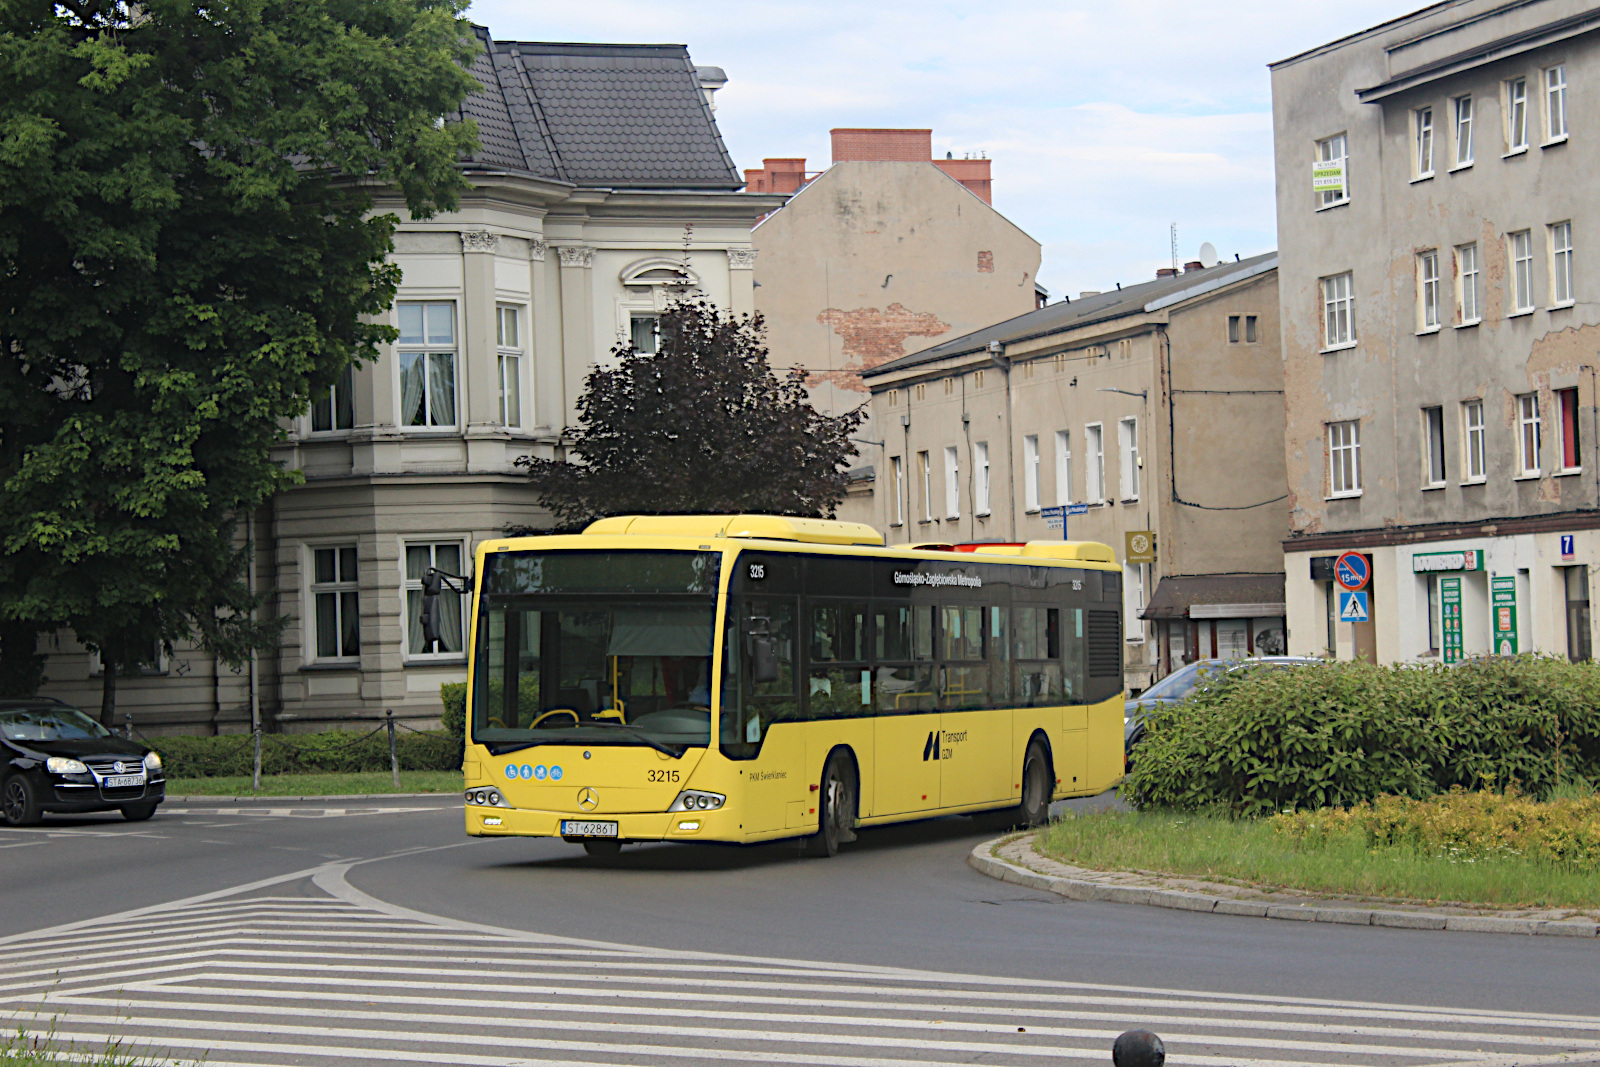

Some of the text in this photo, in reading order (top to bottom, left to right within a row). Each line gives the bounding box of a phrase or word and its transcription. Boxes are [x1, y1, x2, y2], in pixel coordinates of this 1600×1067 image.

[1563, 536, 1571, 554] 7
[750, 564, 765, 579] 3215
[1341, 573, 1351, 583] 15
[894, 571, 982, 589] Górnośląsko-Zagłębiowska Metropolia
[941, 730, 968, 745] Transport
[941, 748, 953, 760] GZM
[108, 777, 121, 787] STA
[647, 769, 680, 783] 3215
[749, 772, 760, 782] PKM
[567, 822, 615, 835] ST 6286T
